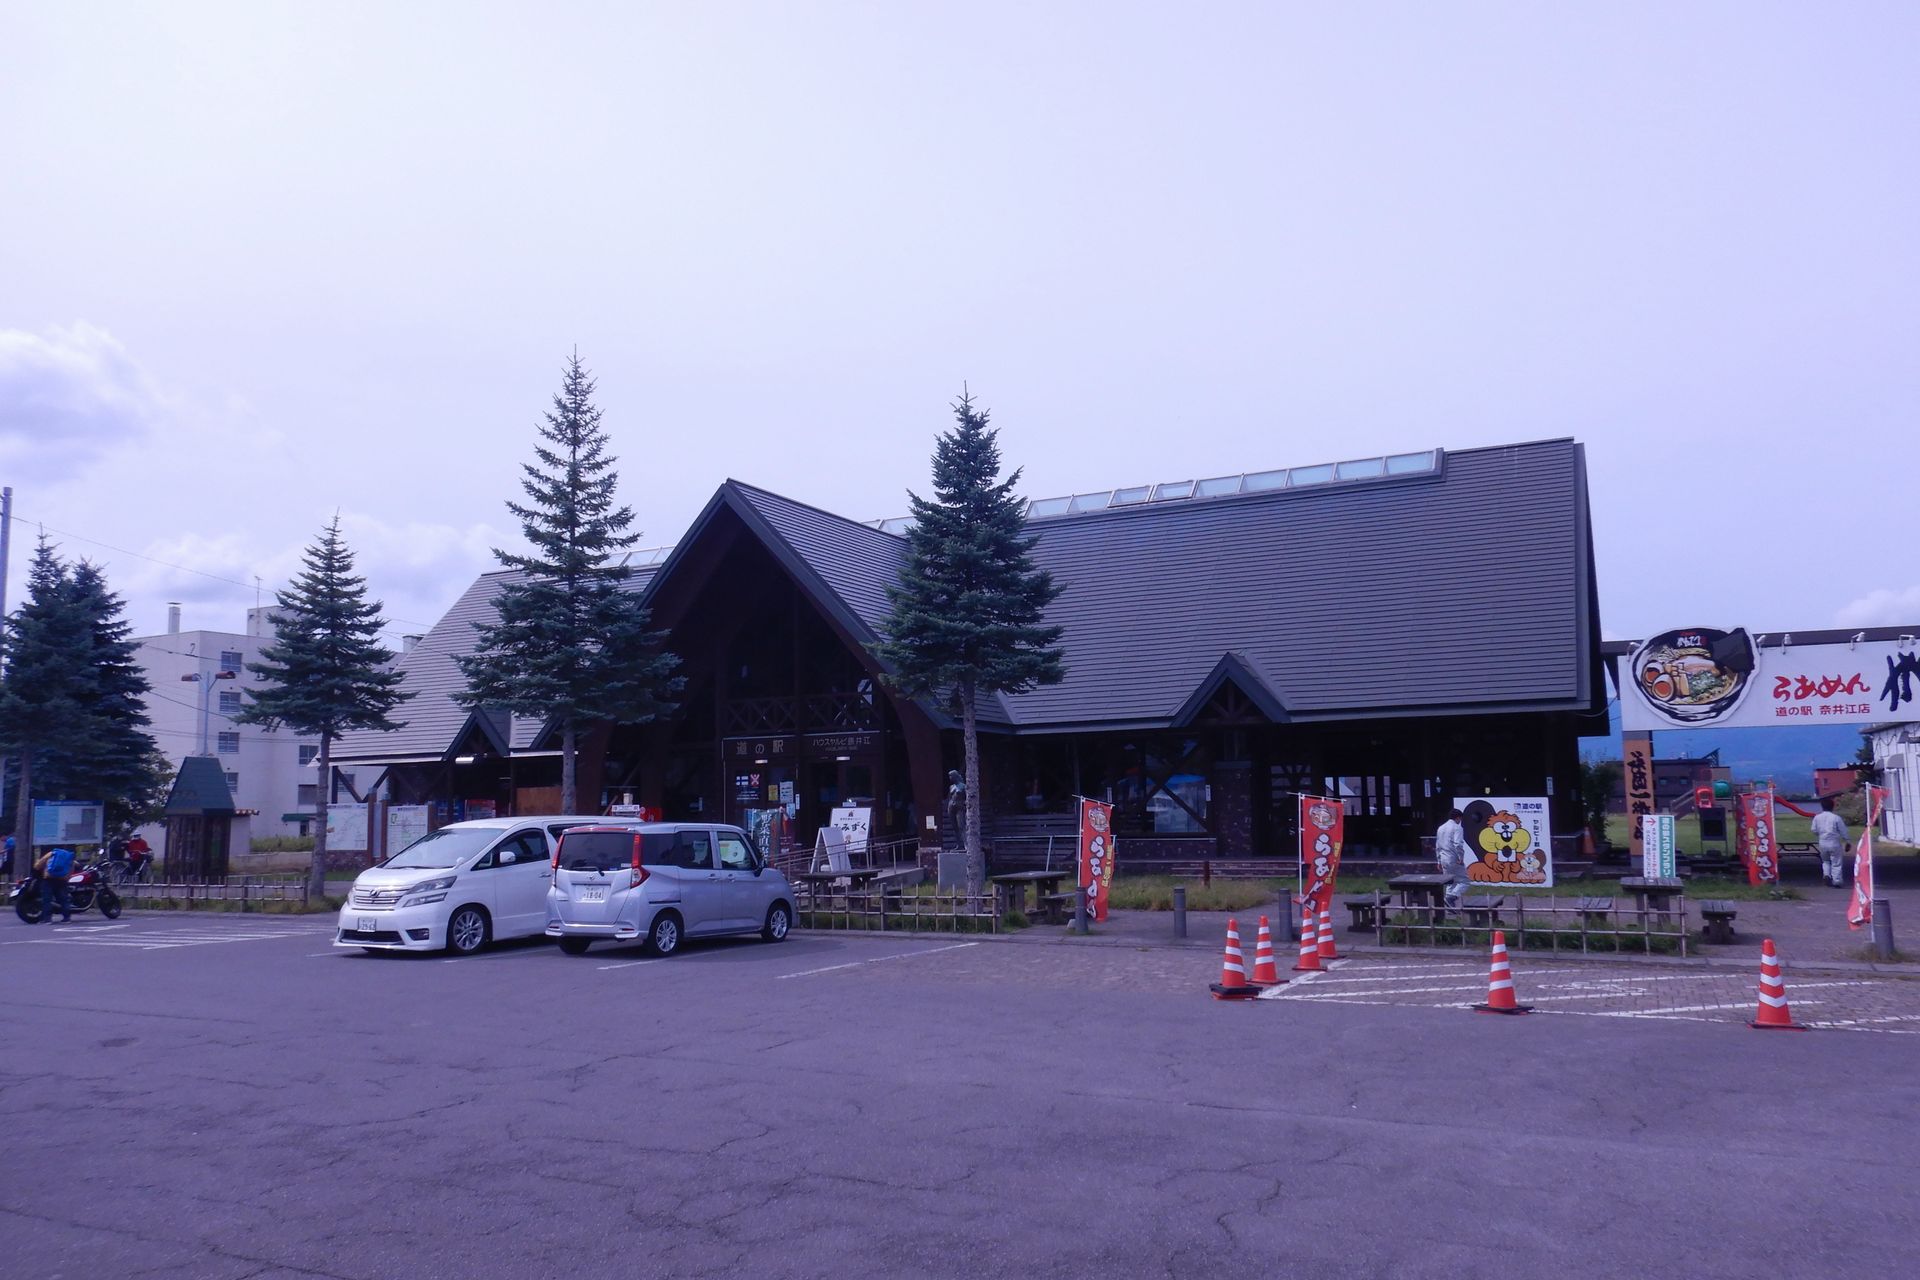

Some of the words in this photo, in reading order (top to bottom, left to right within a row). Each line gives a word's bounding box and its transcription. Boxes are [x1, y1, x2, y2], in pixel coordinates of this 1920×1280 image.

[1773, 672, 1871, 702] らあめん
[1775, 706, 1812, 717] 道の駅
[1819, 703, 1871, 716] 奈井江店
[735, 739, 784, 755] 道の駅
